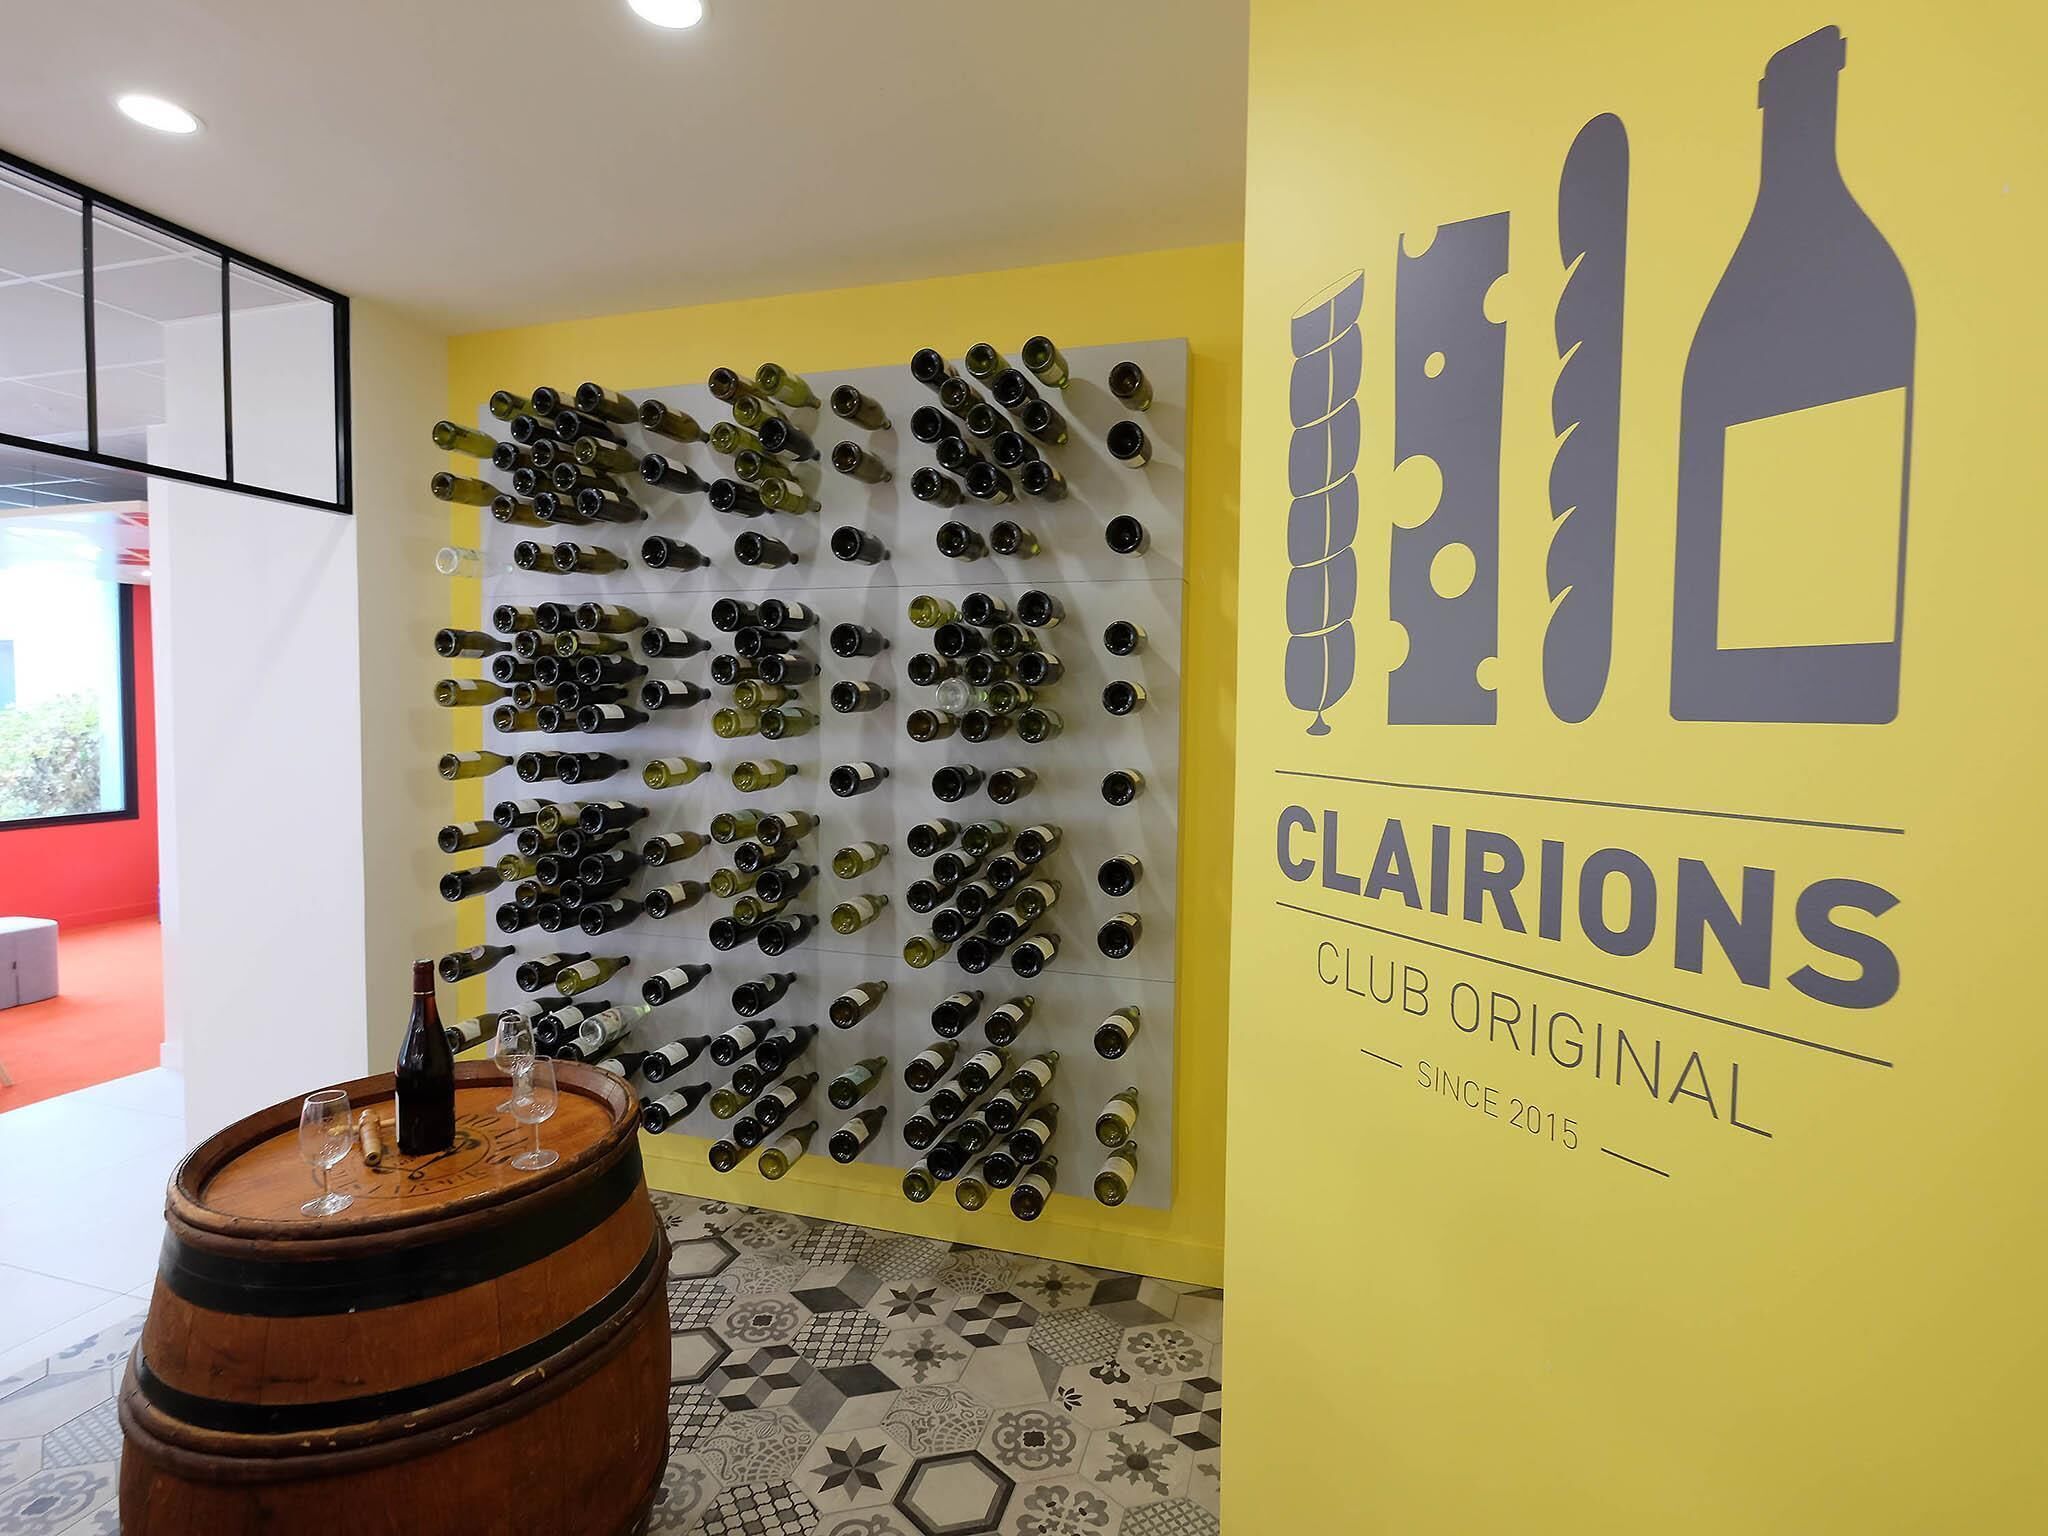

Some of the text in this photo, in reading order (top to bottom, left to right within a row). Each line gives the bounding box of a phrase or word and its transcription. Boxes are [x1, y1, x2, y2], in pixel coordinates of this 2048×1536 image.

[1276, 804, 1901, 1009] CLAIRIONS
[1317, 941, 1774, 1140] CLUB ORIGINAL
[1417, 1060, 1579, 1151] SINCE 2015
